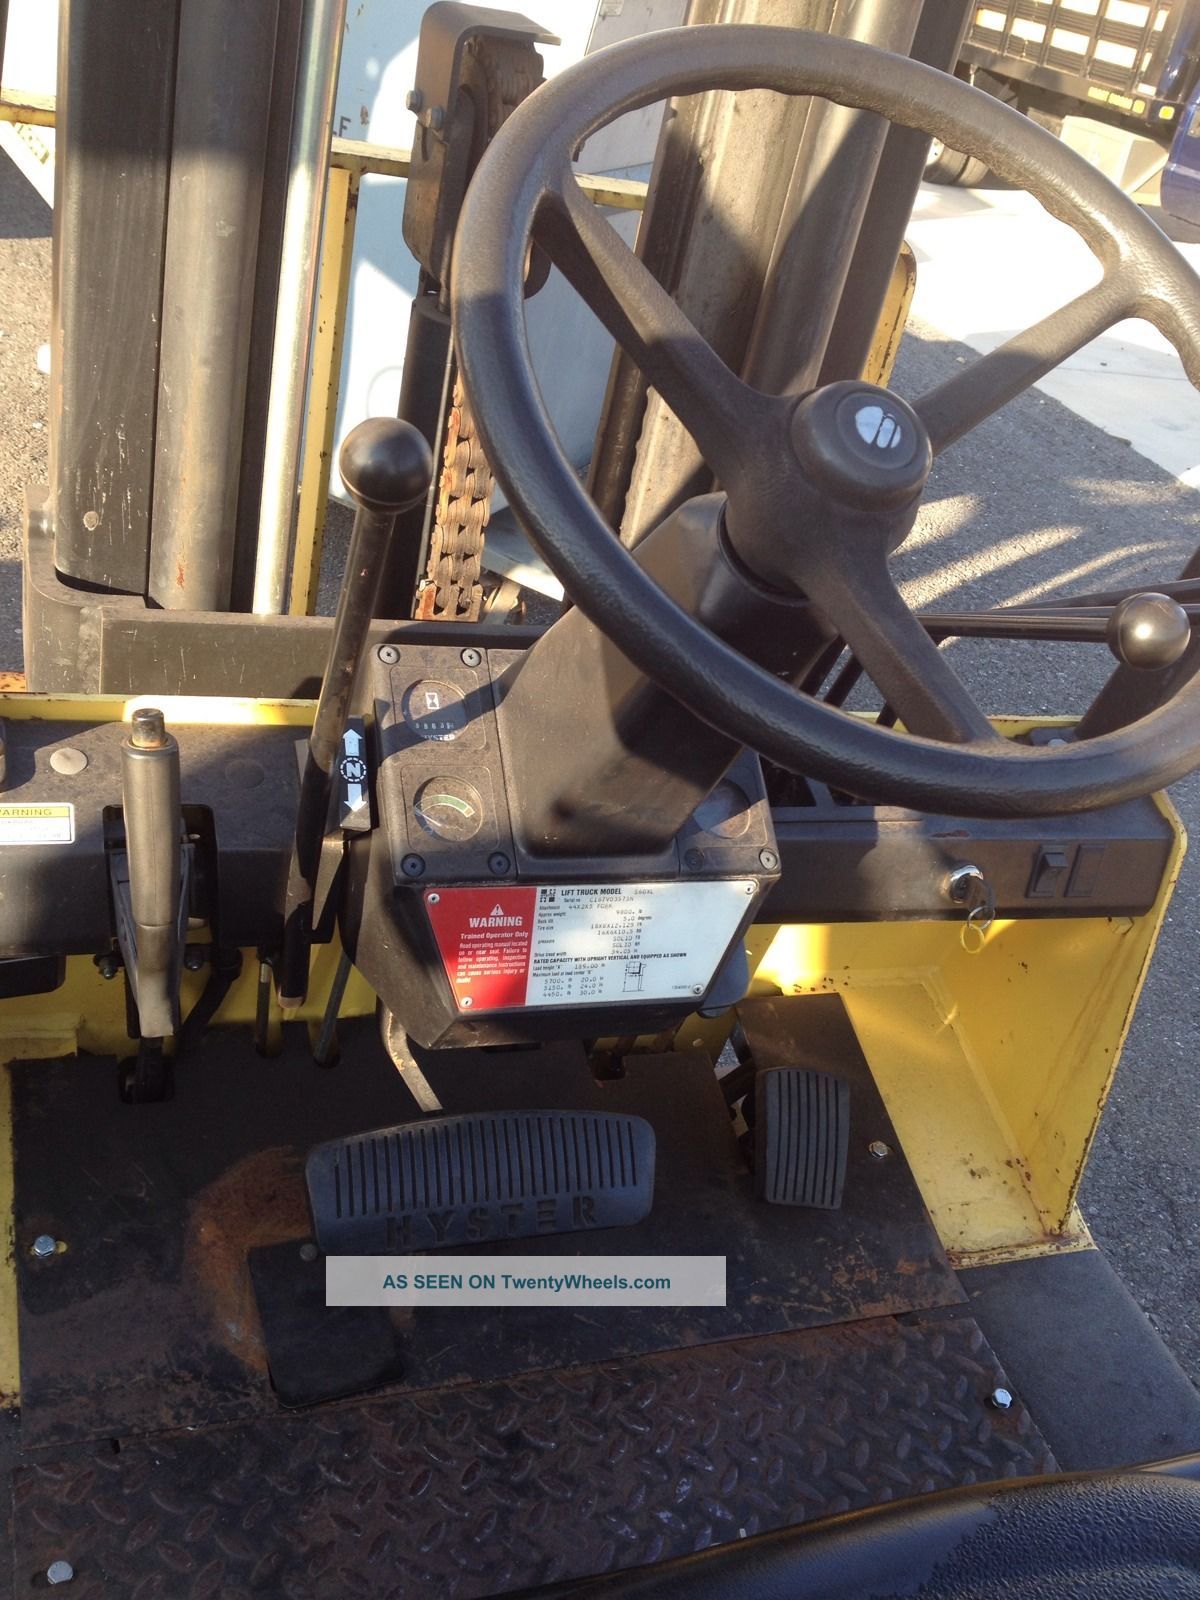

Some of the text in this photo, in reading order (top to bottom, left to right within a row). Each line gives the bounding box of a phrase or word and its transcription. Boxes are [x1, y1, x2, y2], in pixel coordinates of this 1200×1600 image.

[346, 762, 361, 777] N
[0, 808, 52, 816] ARNING
[469, 916, 523, 928] WARNING
[460, 930, 528, 940] Trained Operator Only
[472, 941, 493, 949] operating
[385, 1196, 596, 1248] HYSTER
